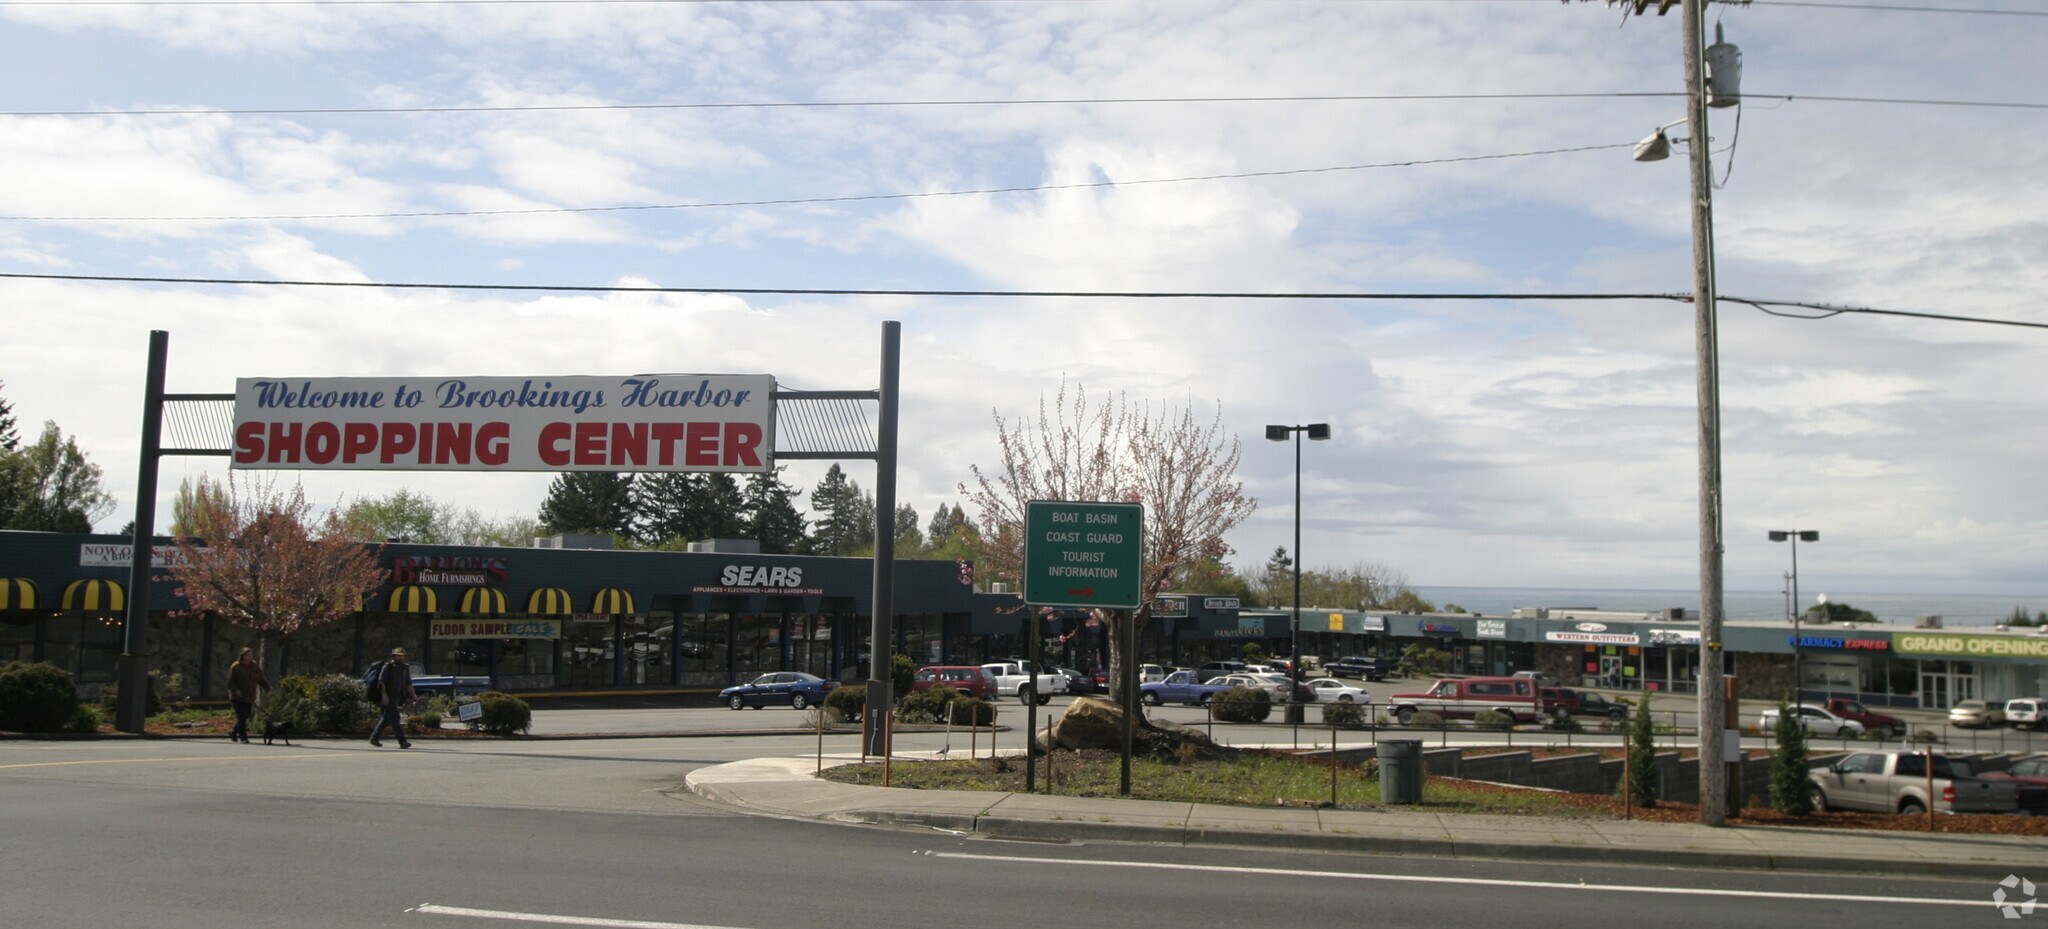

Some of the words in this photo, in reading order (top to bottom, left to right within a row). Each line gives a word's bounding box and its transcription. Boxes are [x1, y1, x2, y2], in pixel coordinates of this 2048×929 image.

[252, 380, 384, 409] Welcome
[394, 384, 424, 408] to
[435, 379, 607, 414] Brookings
[620, 378, 751, 409] Harbor
[235, 421, 510, 465] SHOPPING
[538, 422, 763, 467] CENTER
[1052, 512, 1079, 523] BOAT
[1086, 513, 1118, 524] BASIN
[1046, 531, 1080, 543] COAST
[1087, 533, 1123, 544] GUARD
[84, 545, 118, 557] NOW
[1062, 551, 1105, 562] TOURIST
[721, 565, 802, 587] SEARS
[1049, 566, 1118, 578] INFORMATION
[441, 573, 485, 584] FURNISHINGS
[432, 623, 465, 636] FLOOR
[470, 623, 512, 635] SAMPLE
[516, 625, 547, 634] SALE
[1557, 633, 1590, 642] WESTERN
[1592, 635, 1636, 644] OUTFITTERS
[1845, 638, 1889, 650] EXPRESS
[1902, 636, 1964, 652] GRAND
[1967, 638, 2048, 655] OPENING
